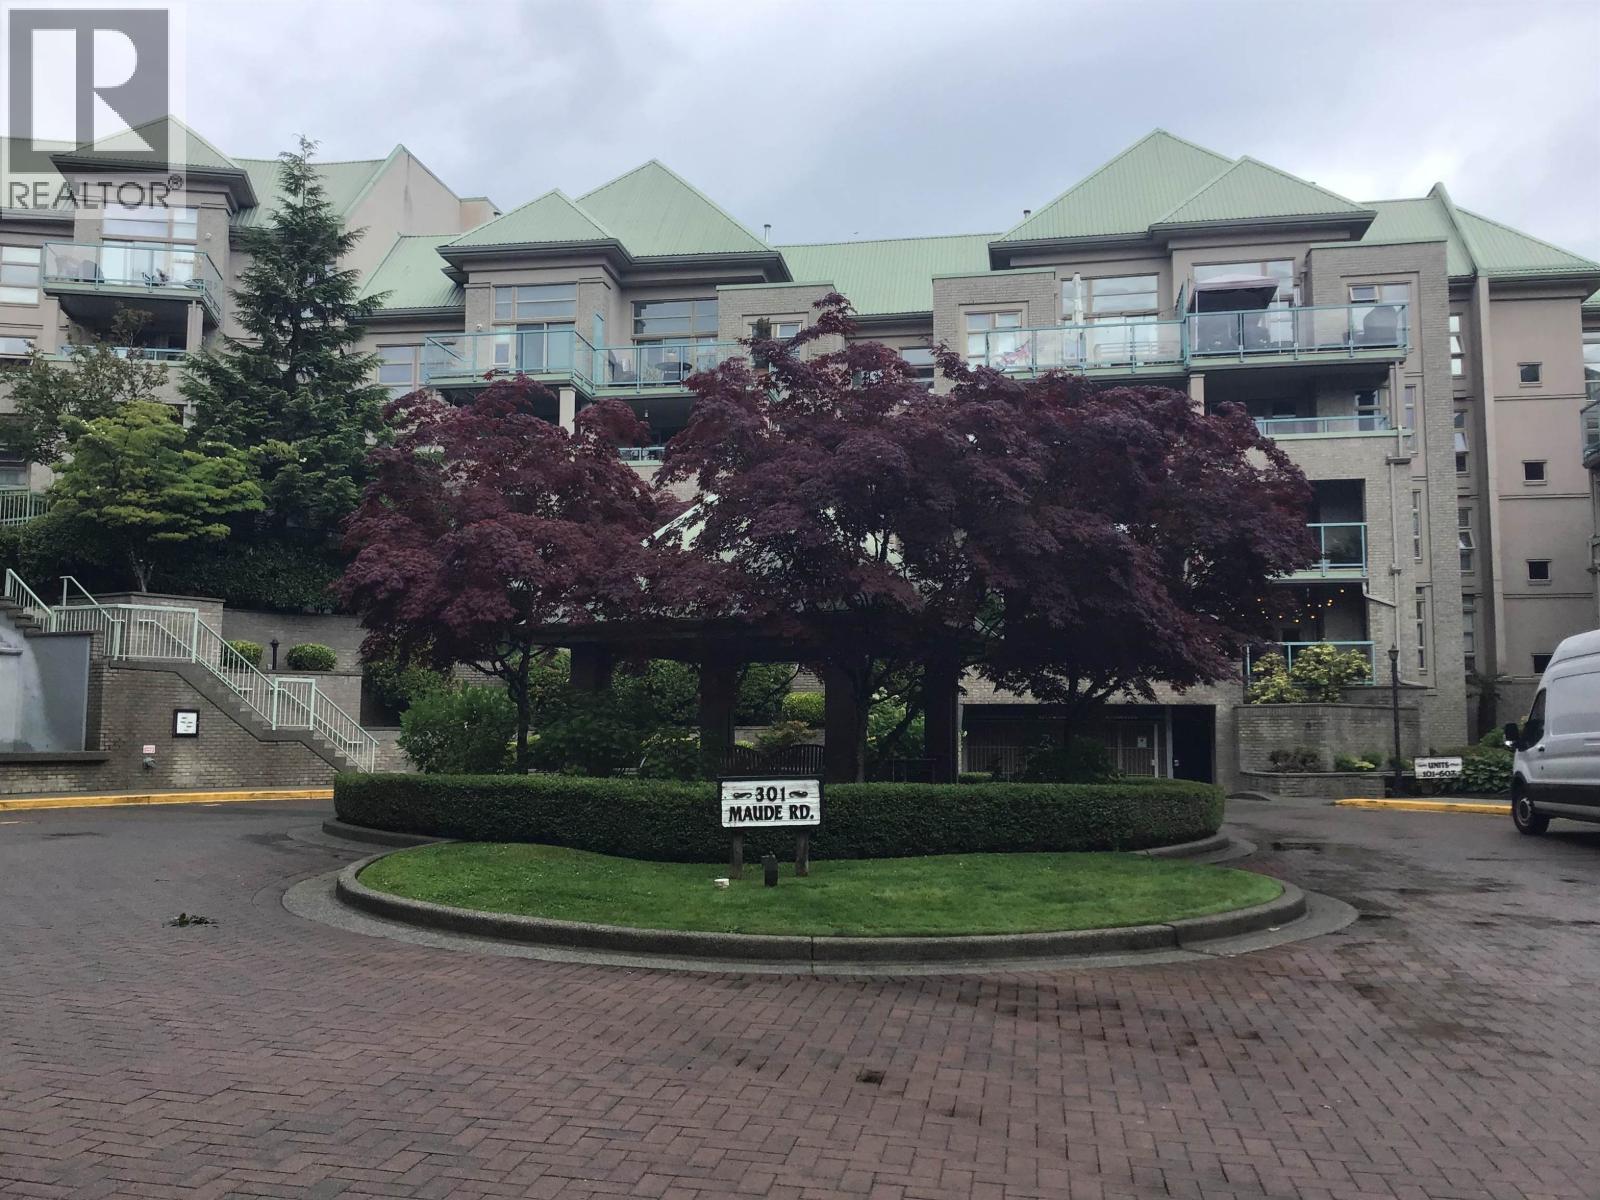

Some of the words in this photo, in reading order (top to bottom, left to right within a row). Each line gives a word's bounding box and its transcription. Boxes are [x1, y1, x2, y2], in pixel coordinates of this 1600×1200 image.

[1427, 761, 1450, 769] UNITS
[755, 786, 786, 802] 301
[728, 804, 783, 822] MAUDE
[789, 804, 815, 820] RD.
